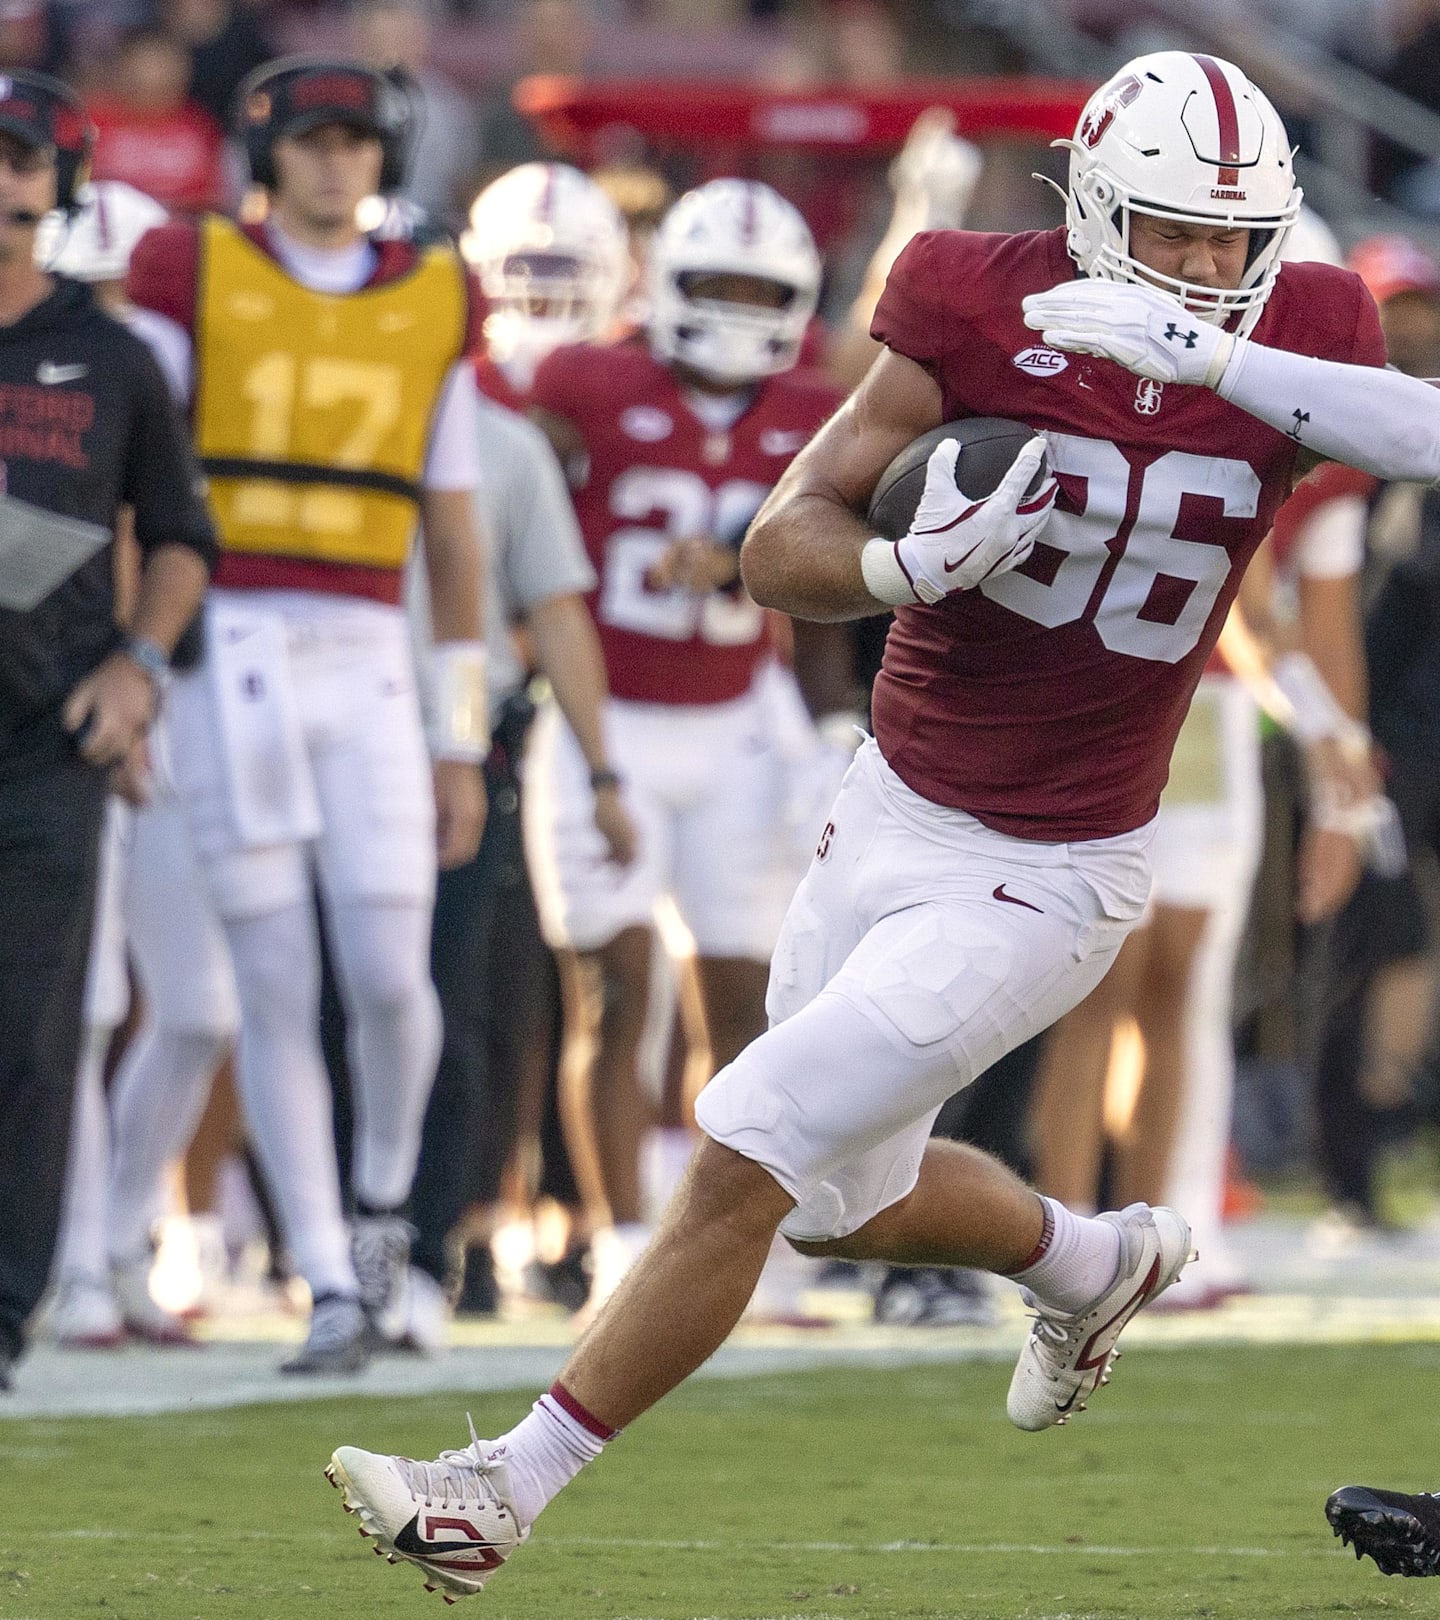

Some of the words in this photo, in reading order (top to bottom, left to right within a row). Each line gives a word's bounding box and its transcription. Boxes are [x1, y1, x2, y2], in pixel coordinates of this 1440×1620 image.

[1210, 188, 1247, 201] CARDINAL
[1020, 352, 1063, 368] ACC
[231, 351, 403, 533] 17
[979, 429, 1263, 665] 86
